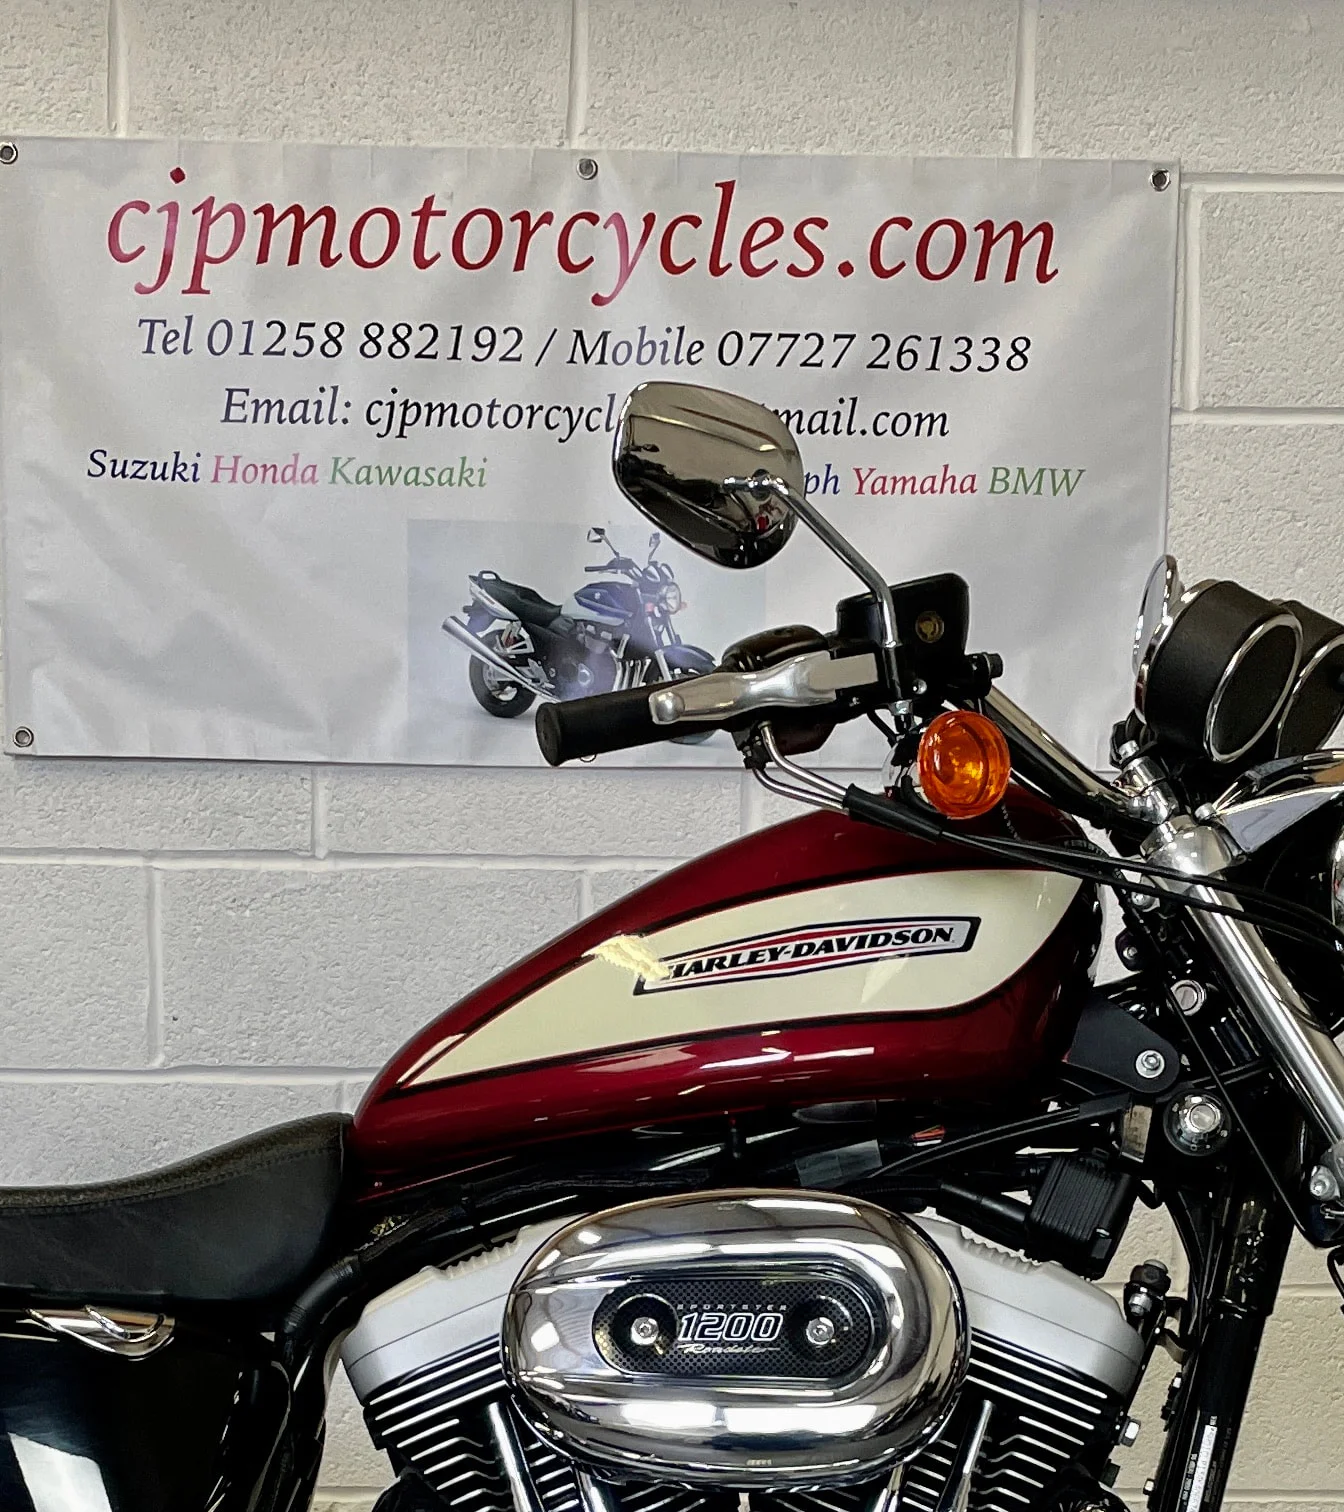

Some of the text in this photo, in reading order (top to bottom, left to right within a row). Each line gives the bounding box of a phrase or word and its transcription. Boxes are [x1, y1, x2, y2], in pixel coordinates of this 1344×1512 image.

[108, 168, 1058, 307] cjpmotorcycles.com
[138, 315, 1032, 373] Tel 01258 882192 / Mobile 07727 261338
[220, 385, 352, 426] Email:
[87, 448, 488, 488] Suzuki Honda Kawasaki
[852, 464, 978, 496] Yamaha
[988, 467, 1086, 497] BMW
[677, 1312, 784, 1341] 1200
